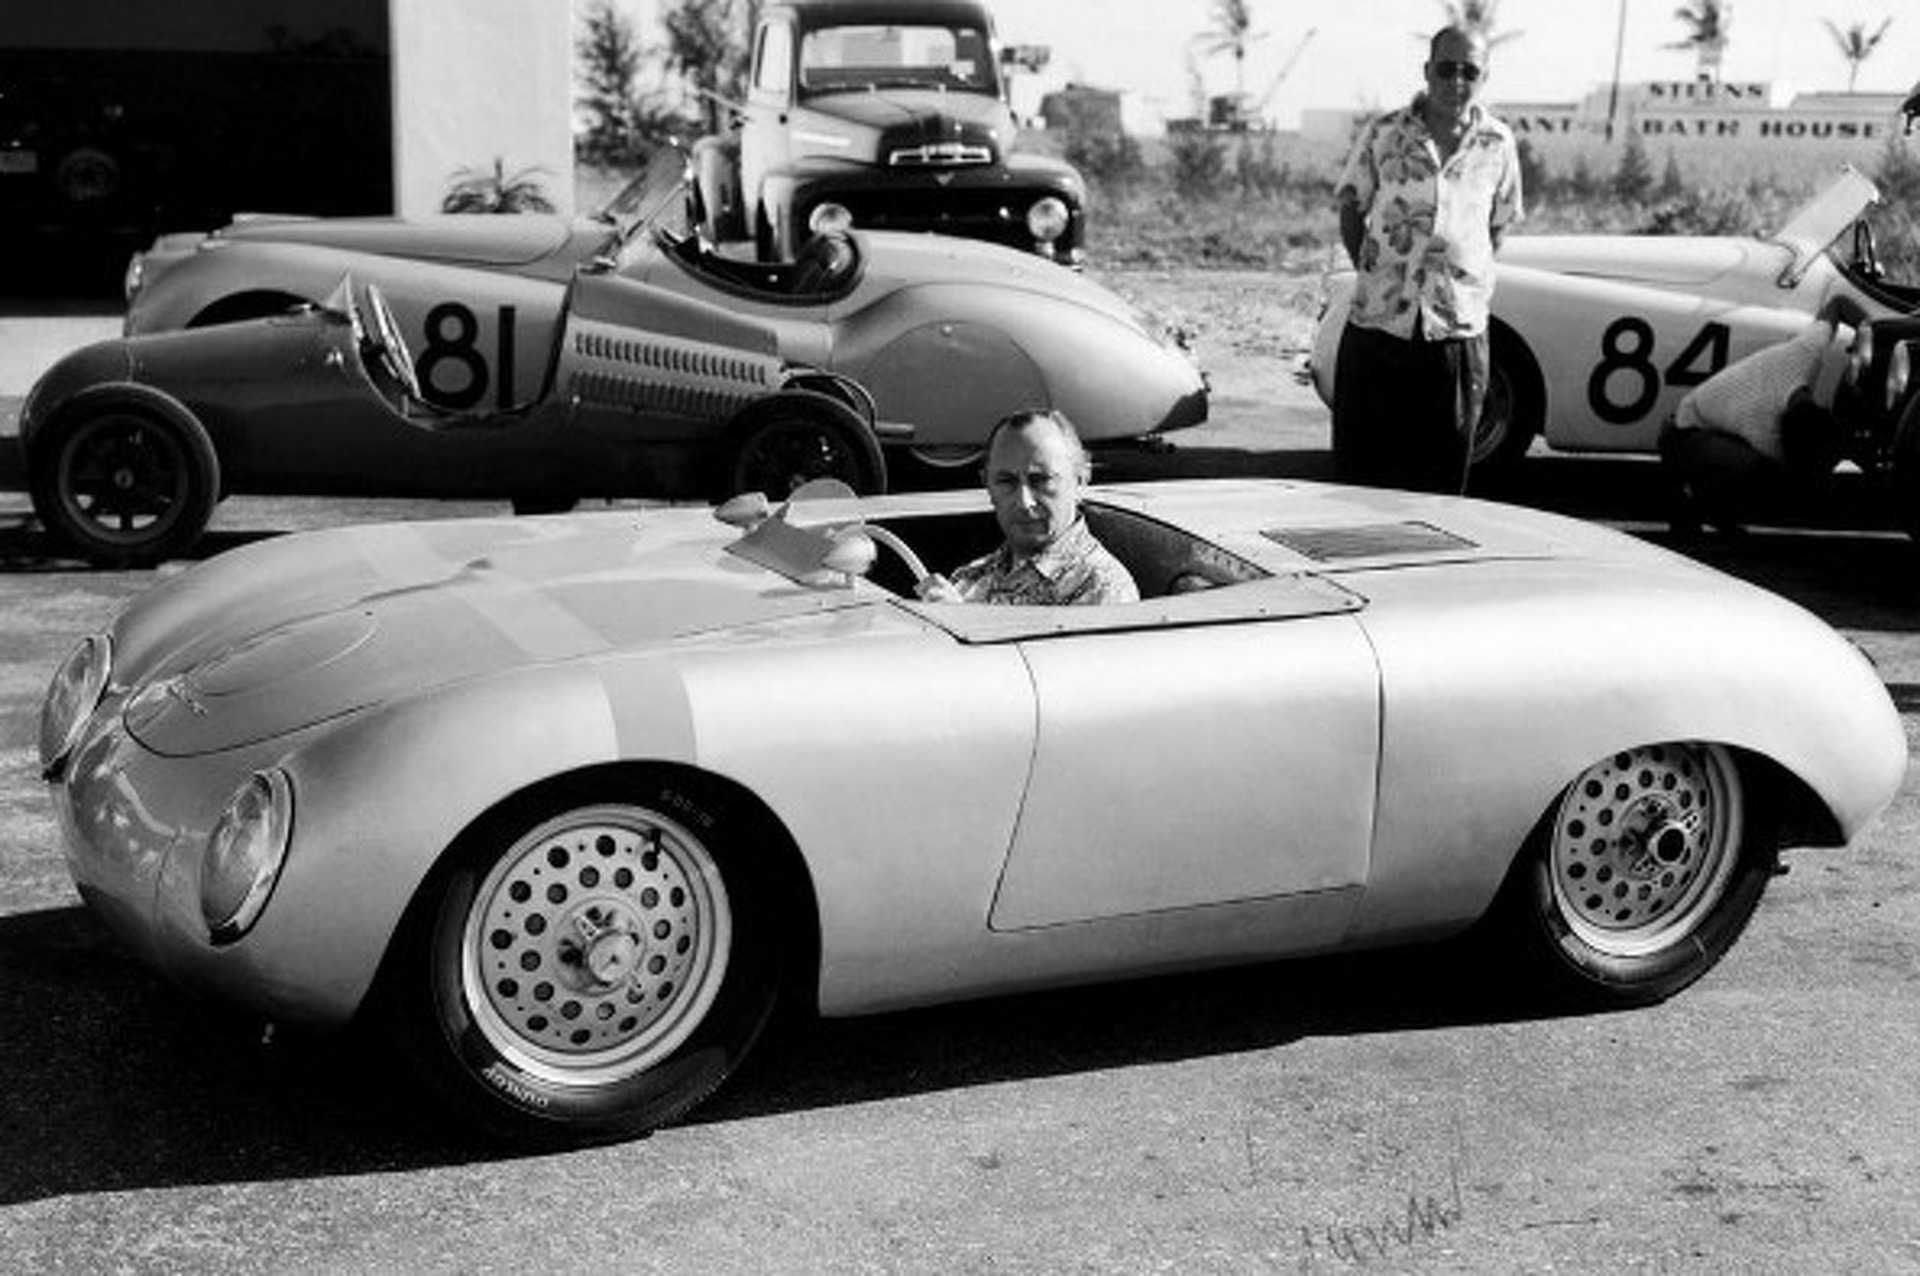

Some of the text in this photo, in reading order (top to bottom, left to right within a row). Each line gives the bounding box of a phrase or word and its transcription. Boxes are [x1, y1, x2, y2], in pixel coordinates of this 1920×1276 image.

[1499, 117, 1571, 133] ANT
[1643, 119, 1883, 138] BATH HOUSE
[415, 301, 516, 411] 81
[1588, 316, 1730, 425] 84
